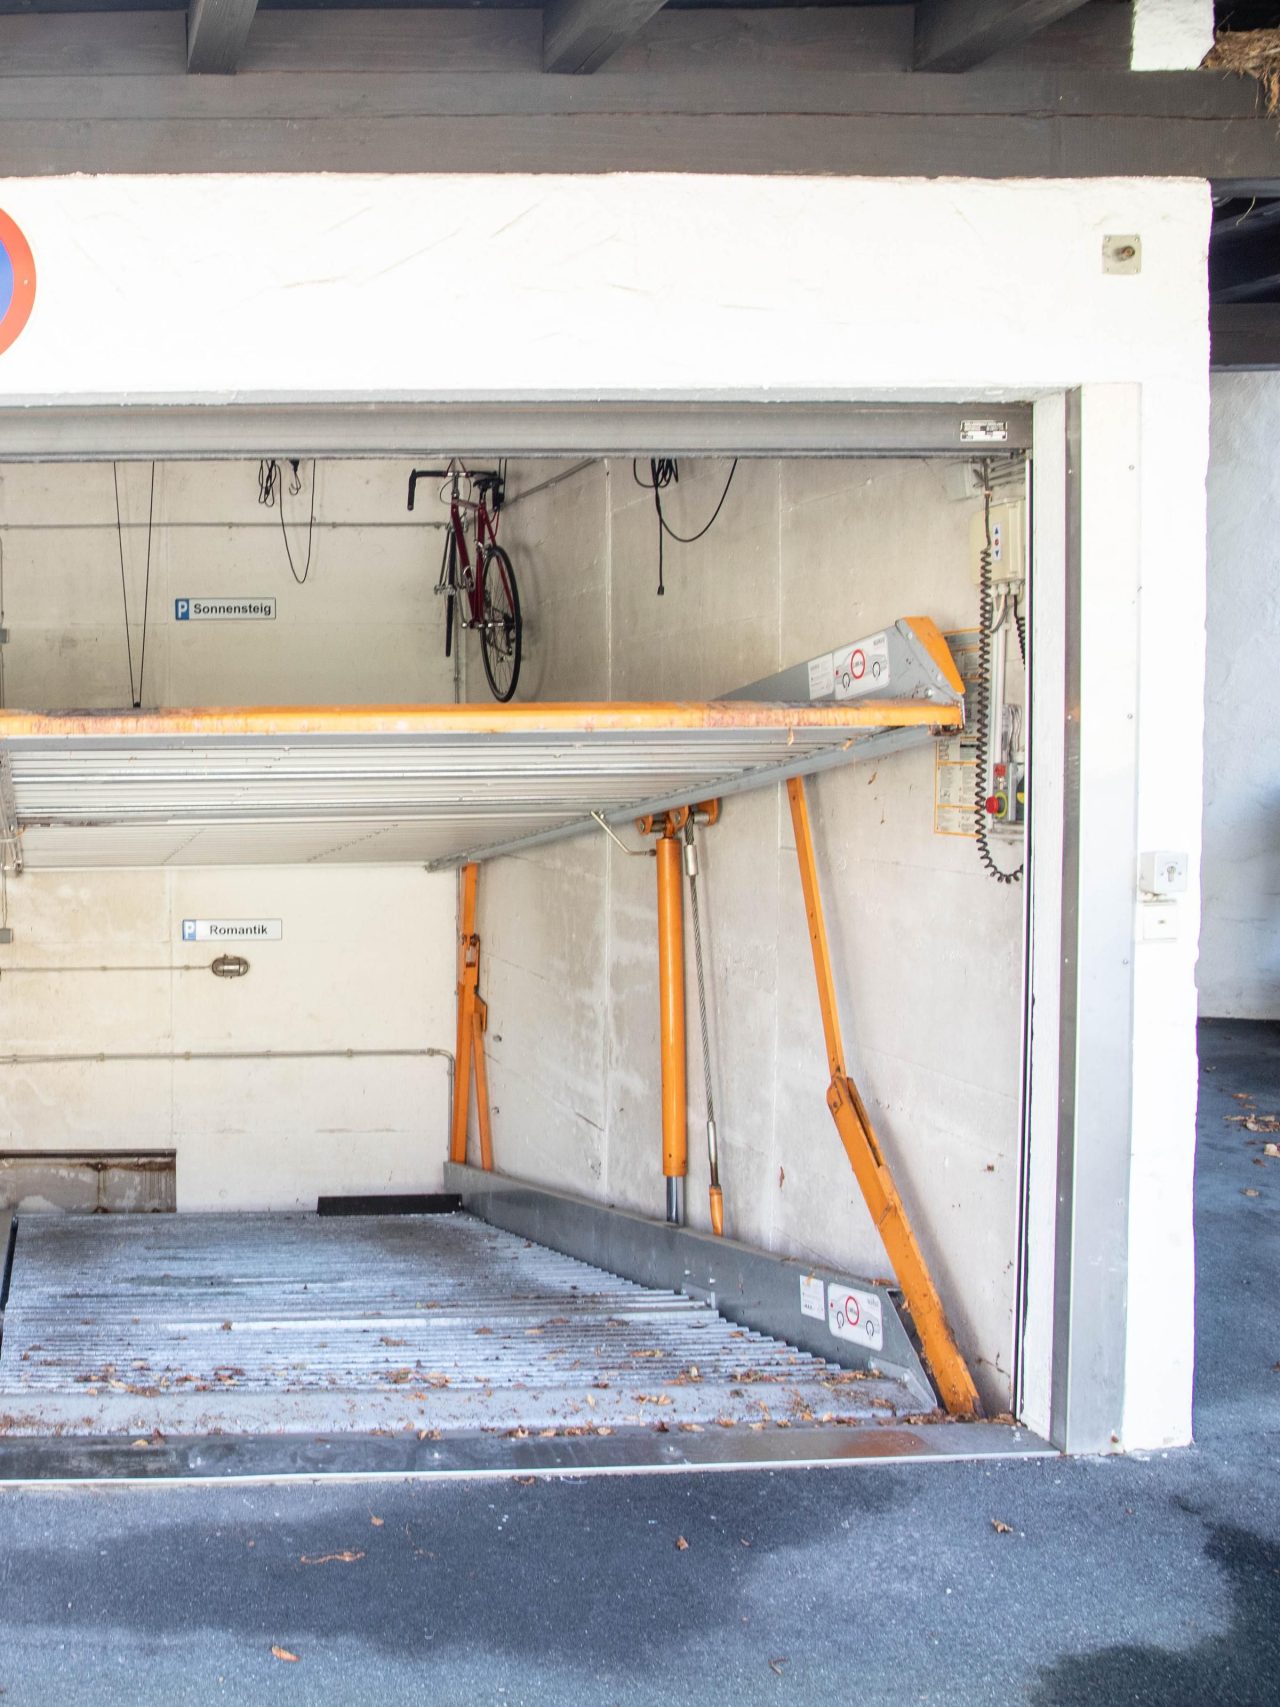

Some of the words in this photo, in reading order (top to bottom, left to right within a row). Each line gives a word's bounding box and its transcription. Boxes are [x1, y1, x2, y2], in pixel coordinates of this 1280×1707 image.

[178, 601, 188, 618] P
[193, 603, 271, 616] Sonnensteig
[184, 921, 195, 939] P
[209, 925, 268, 935] Romantik
